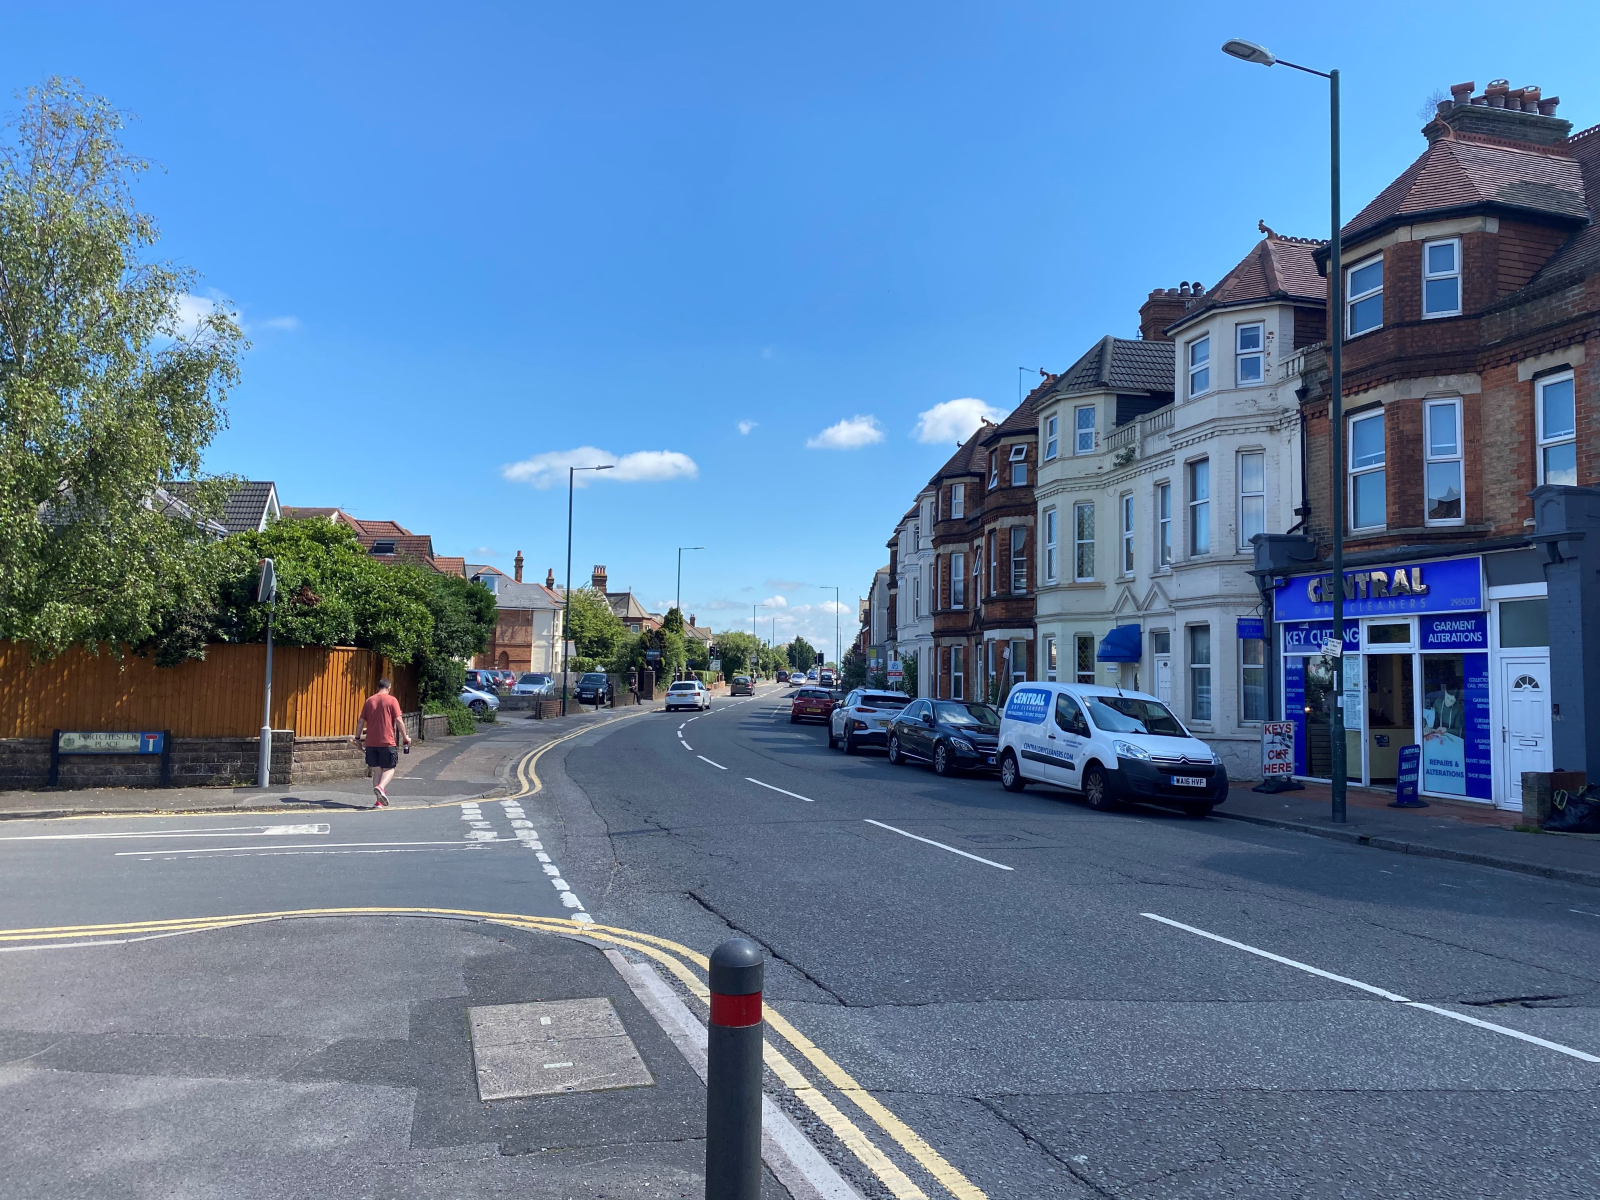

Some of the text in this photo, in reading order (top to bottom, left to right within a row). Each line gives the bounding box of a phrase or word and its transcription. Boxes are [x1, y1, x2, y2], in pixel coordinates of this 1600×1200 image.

[1307, 567, 1428, 603] CENTRAL
[1350, 598, 1426, 613] CLEANERS
[1450, 597, 1476, 607] 295020
[1433, 620, 1476, 631] GARMENT
[1285, 630, 1306, 645] KEY
[1428, 632, 1483, 643] ALTERATIONS
[1013, 692, 1046, 706] CENTRAL
[1264, 723, 1292, 735] KEYS
[1023, 742, 1074, 761] CENTRALDRYCLEANERS.COM
[1267, 749, 1289, 760] CUT
[1263, 762, 1292, 774] HERE
[1429, 758, 1460, 768] REPAIRS &
[1425, 769, 1465, 779] ALTERATIONS
